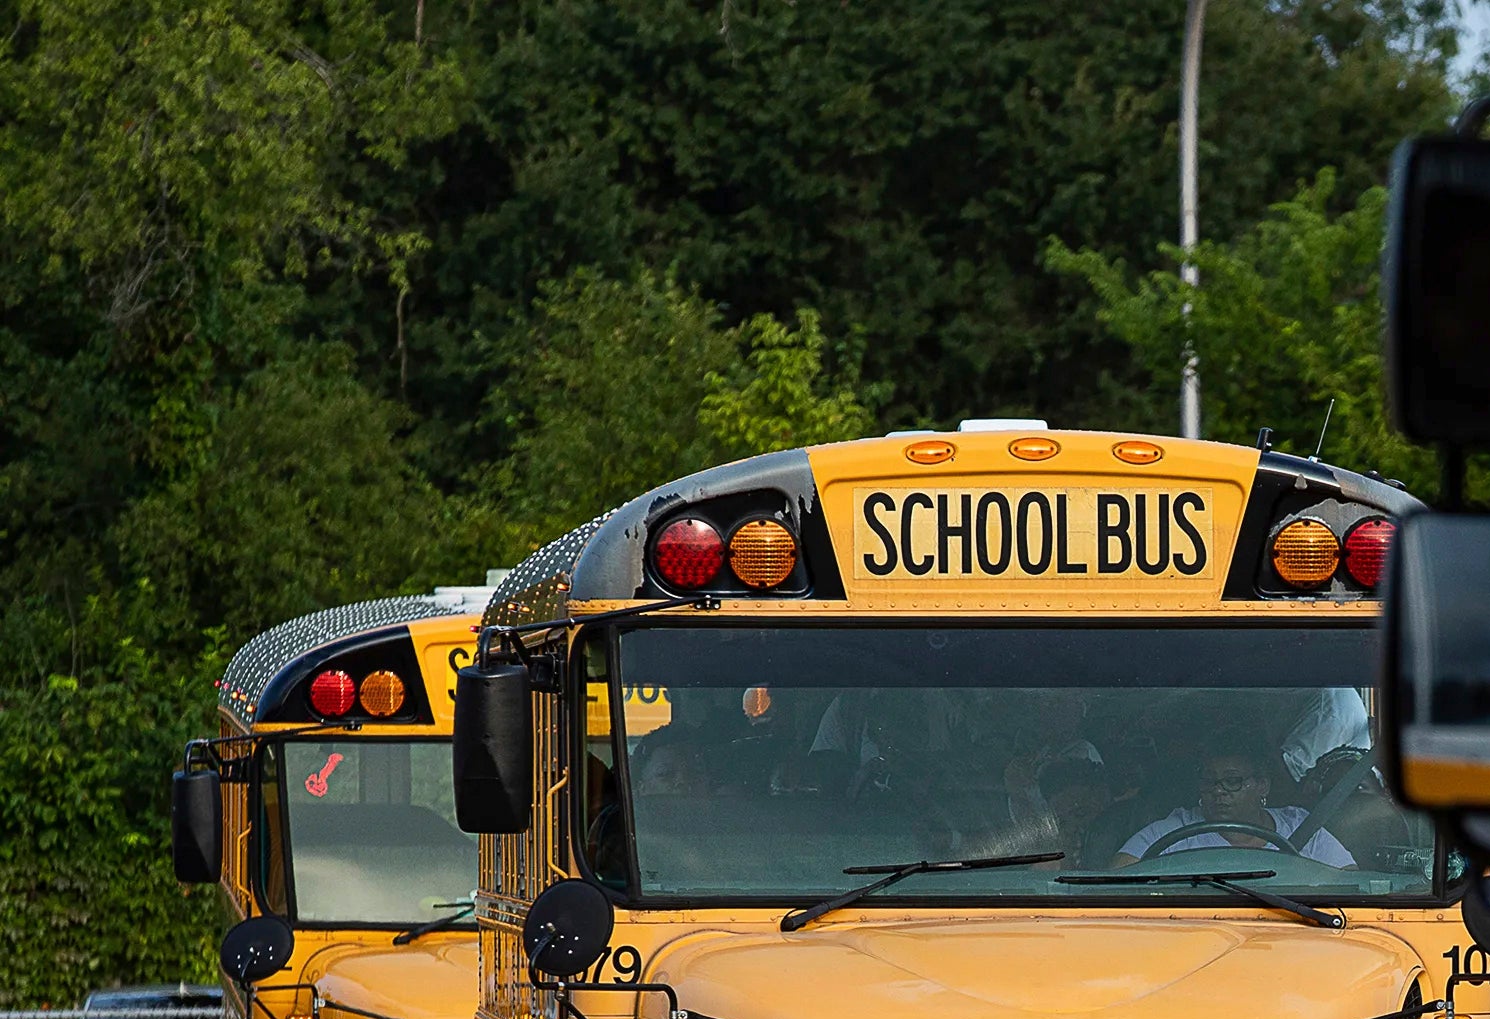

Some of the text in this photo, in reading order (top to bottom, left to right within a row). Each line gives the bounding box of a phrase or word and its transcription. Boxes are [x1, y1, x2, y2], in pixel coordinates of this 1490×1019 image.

[863, 491, 1207, 576] SCHOOL BUS
[574, 945, 642, 984] 79
